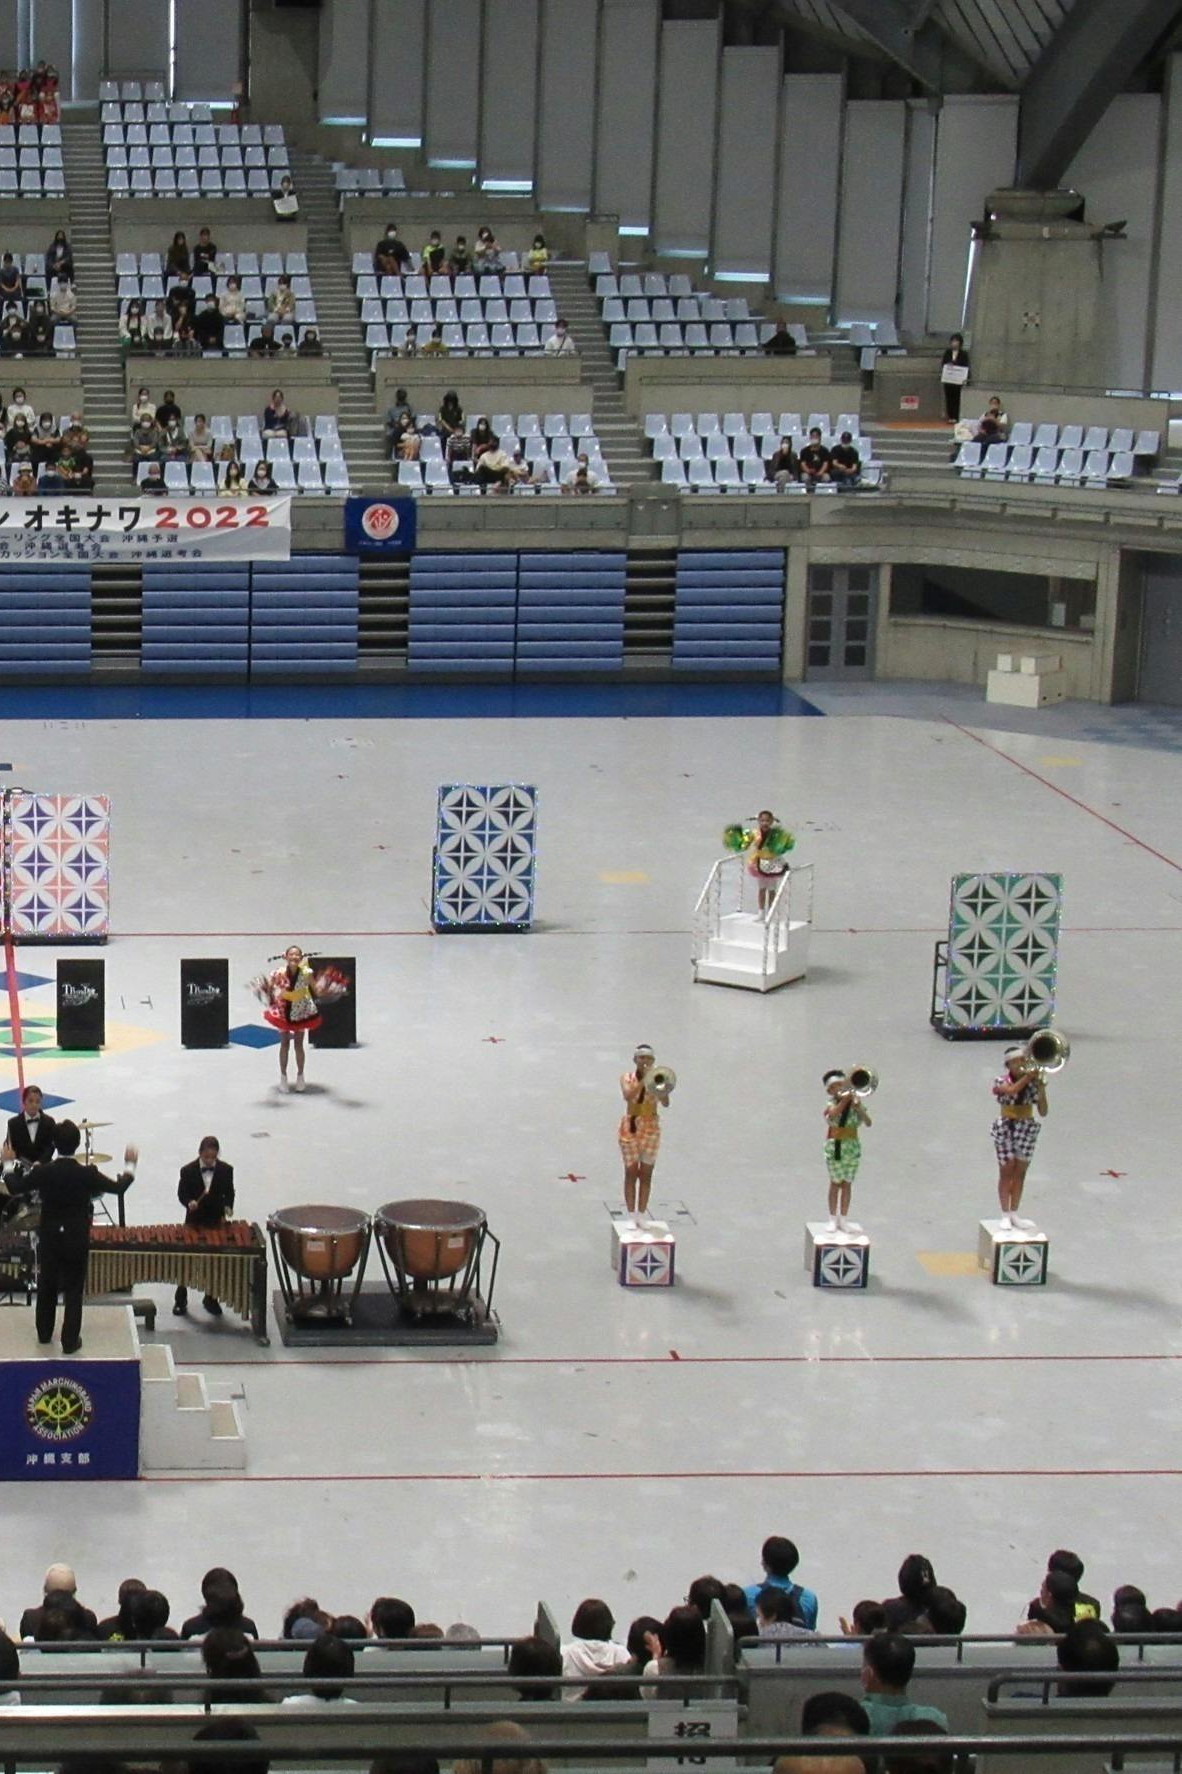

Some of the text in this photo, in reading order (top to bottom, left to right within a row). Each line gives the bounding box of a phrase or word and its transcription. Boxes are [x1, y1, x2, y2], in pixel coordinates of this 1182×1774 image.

[24, 504, 141, 532] オキナワ
[155, 505, 270, 529] 2022
[32, 1423, 85, 1441] ASSOCIATION
